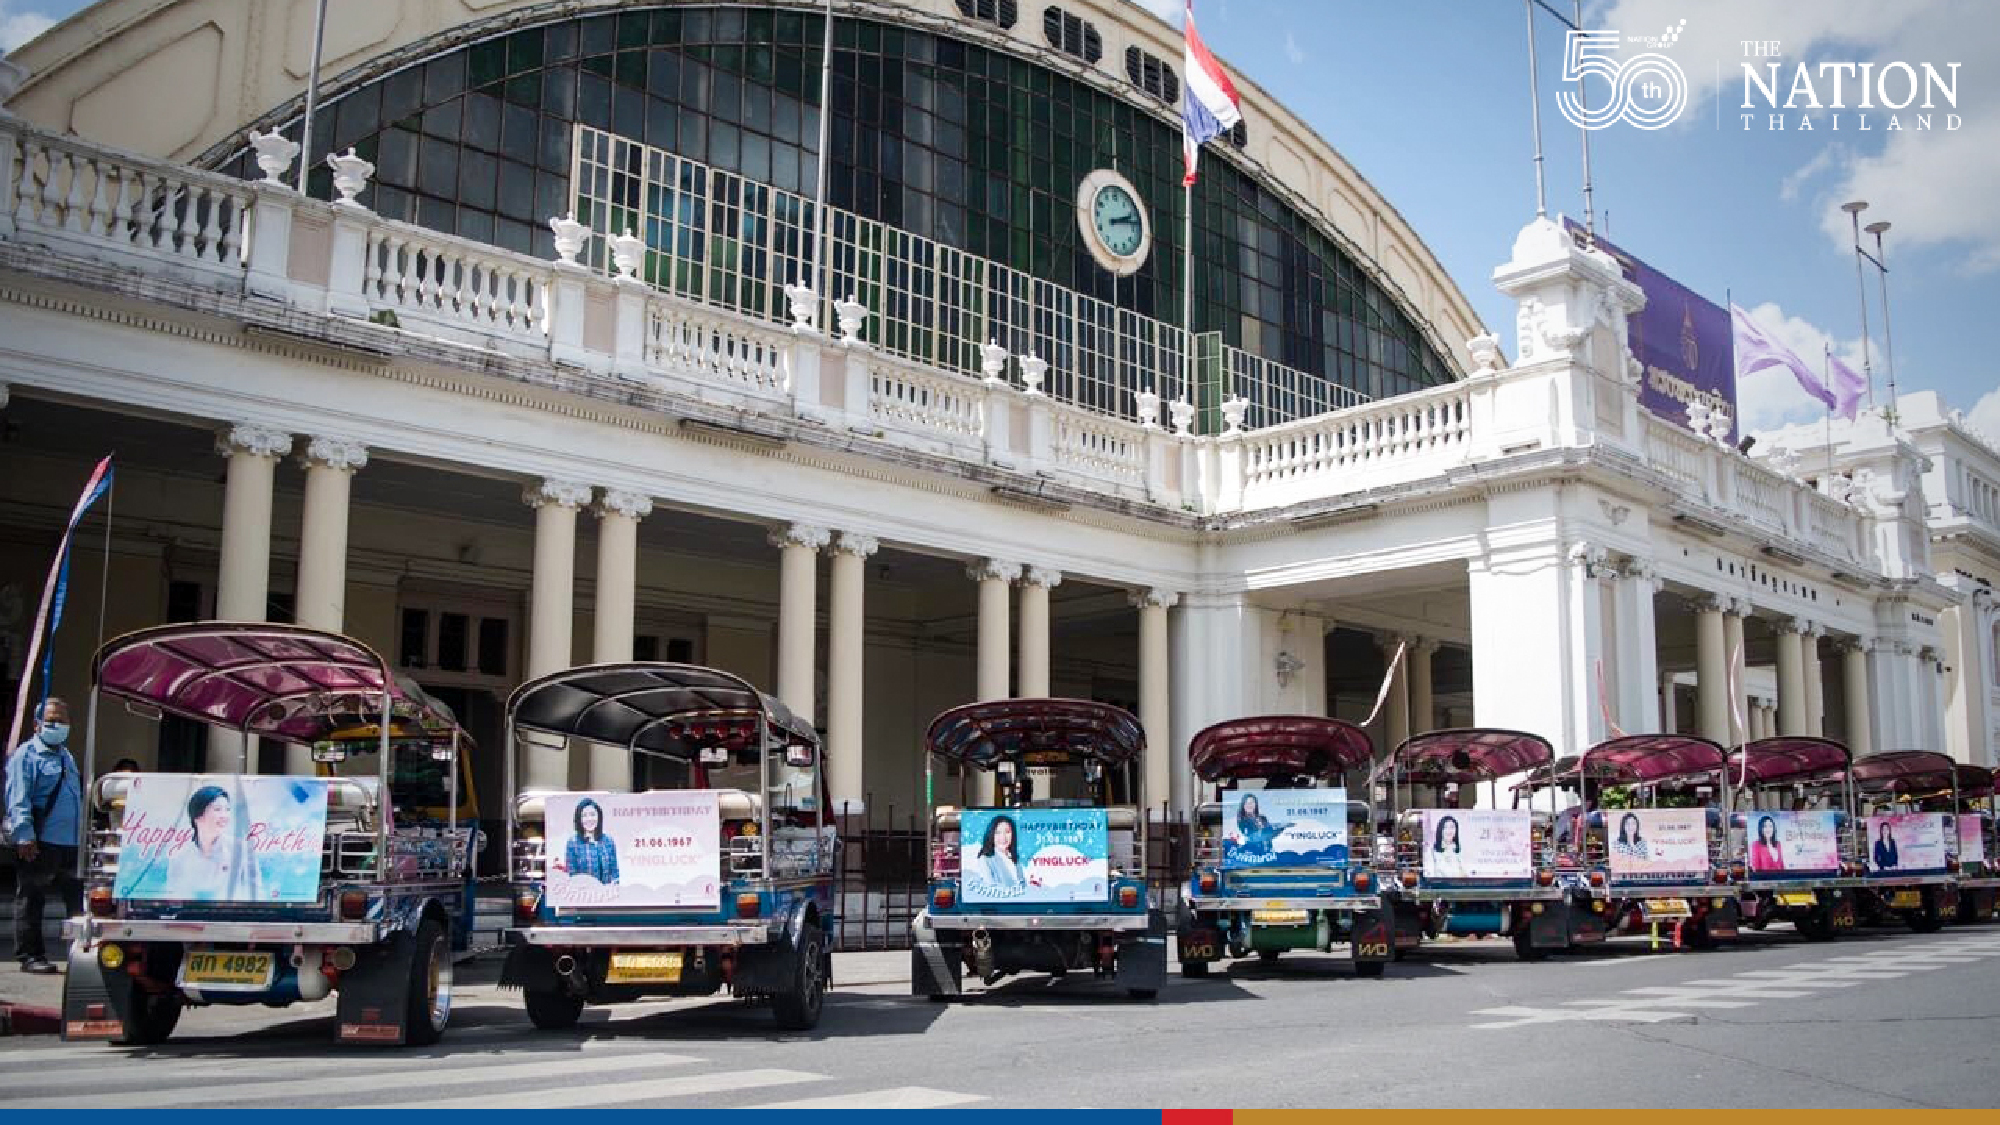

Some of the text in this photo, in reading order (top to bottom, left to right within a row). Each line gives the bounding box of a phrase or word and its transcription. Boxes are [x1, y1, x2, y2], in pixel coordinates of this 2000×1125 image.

[122, 811, 192, 857] Happy
[634, 836, 692, 848] 21.06.1967
[222, 954, 269, 974] 4982
